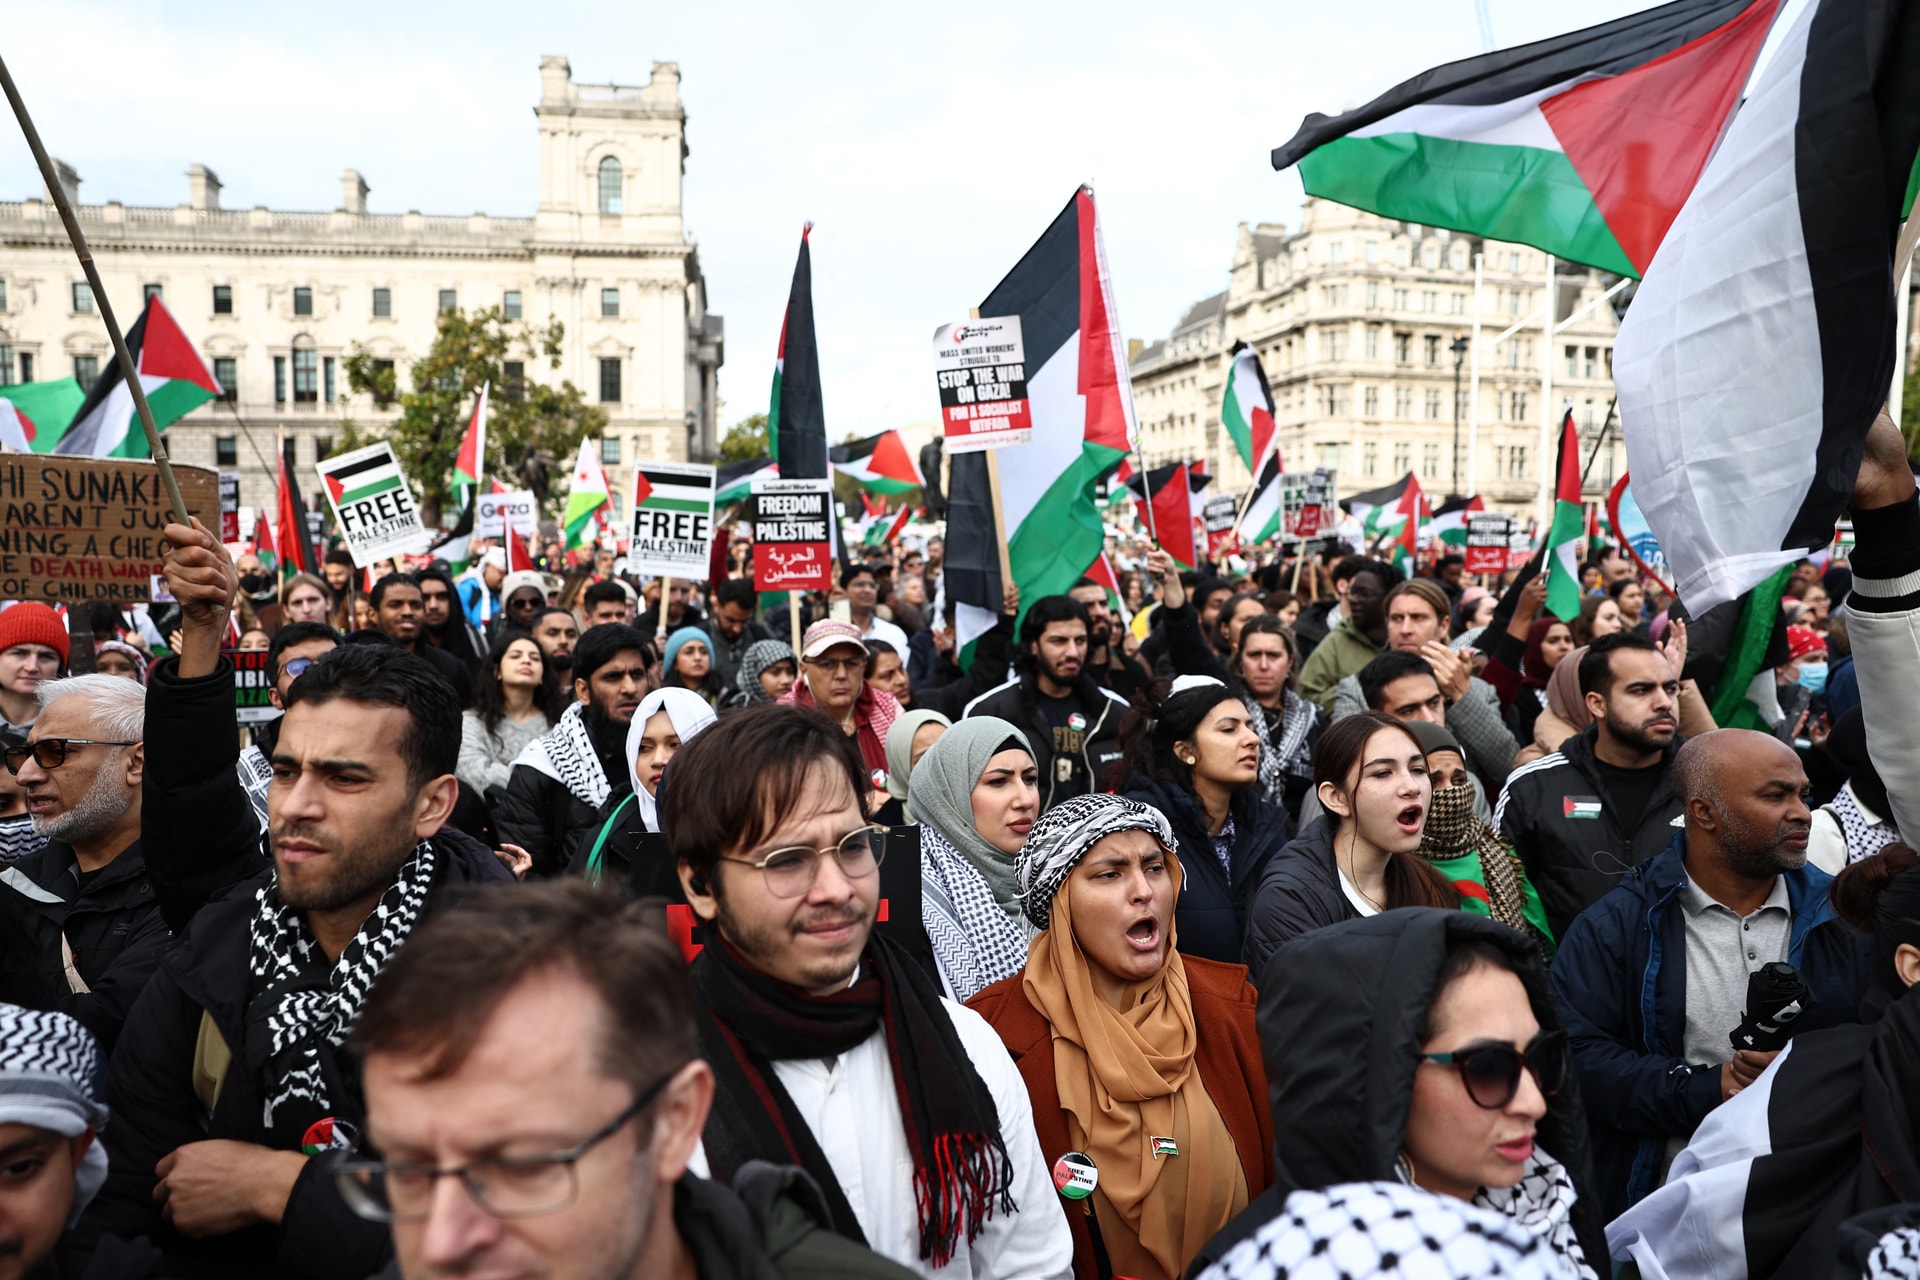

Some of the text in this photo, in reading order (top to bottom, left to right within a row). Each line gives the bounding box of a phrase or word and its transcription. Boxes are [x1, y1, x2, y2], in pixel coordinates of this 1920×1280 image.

[940, 349, 959, 358] MASS
[961, 346, 983, 356] UNITED
[960, 355, 1000, 366] STRUGGLE TO
[939, 364, 1025, 389] STOP THE WAR
[957, 382, 1012, 404] ON GAZA!
[950, 400, 1022, 421] FOR A SOCIALIST
[969, 415, 1011, 433] INTIFADA
[41, 467, 160, 506] SUNAK!
[339, 488, 413, 532] FREE
[758, 494, 822, 515] FREEDOM
[349, 514, 416, 545] PALESTINE
[634, 510, 709, 541] FREE
[756, 521, 826, 541] PALESTINE
[83, 535, 100, 559] A
[632, 538, 706, 555] PALESTINE
[769, 546, 815, 566] الحرية
[30, 557, 104, 580] DEATH
[763, 563, 822, 583] لفلسطين
[3, 578, 148, 600] OF CHILDREN
[223, 652, 268, 670] TOP
[1056, 1171, 1094, 1185] PALESTINE
[1067, 1167, 1085, 1176] FREE
